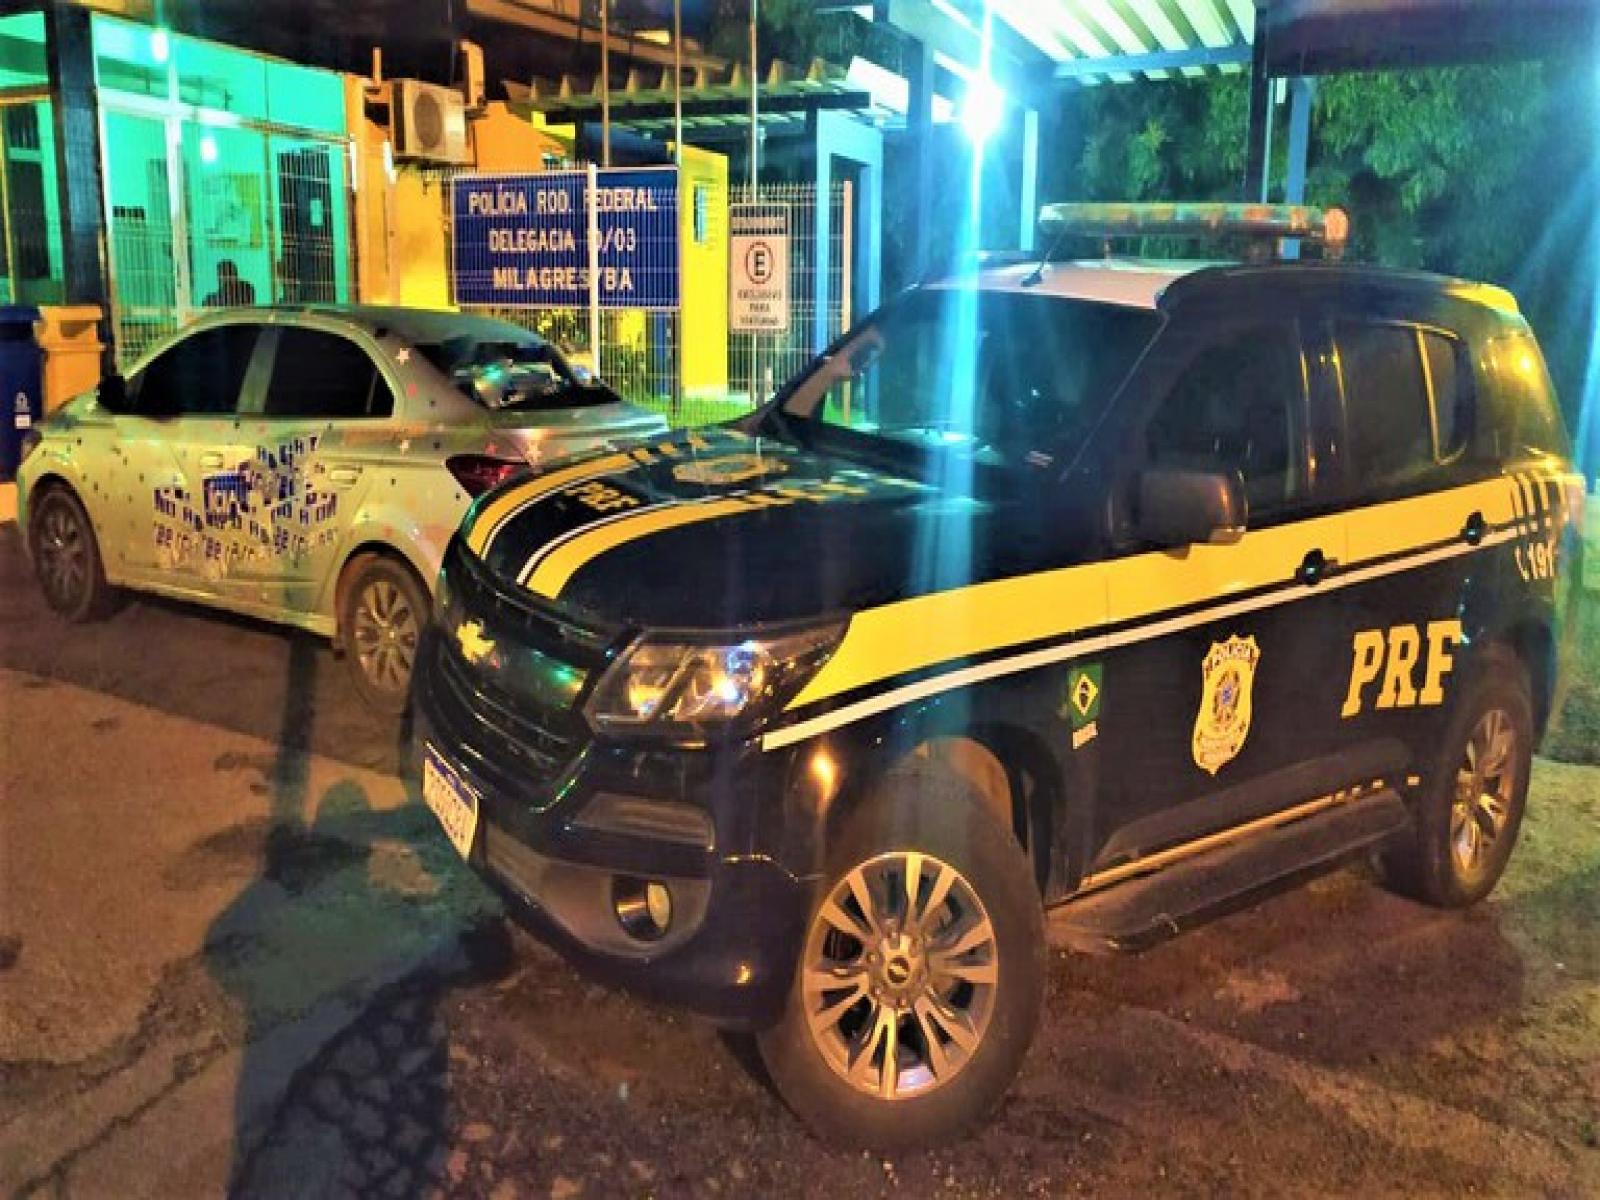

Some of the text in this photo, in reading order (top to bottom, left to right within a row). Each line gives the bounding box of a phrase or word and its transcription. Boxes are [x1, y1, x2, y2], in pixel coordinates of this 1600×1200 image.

[583, 187, 657, 212] FEDERAL
[489, 228, 576, 252] DELEGACIA
[754, 251, 765, 276] E
[1341, 619, 1462, 719] PRF
